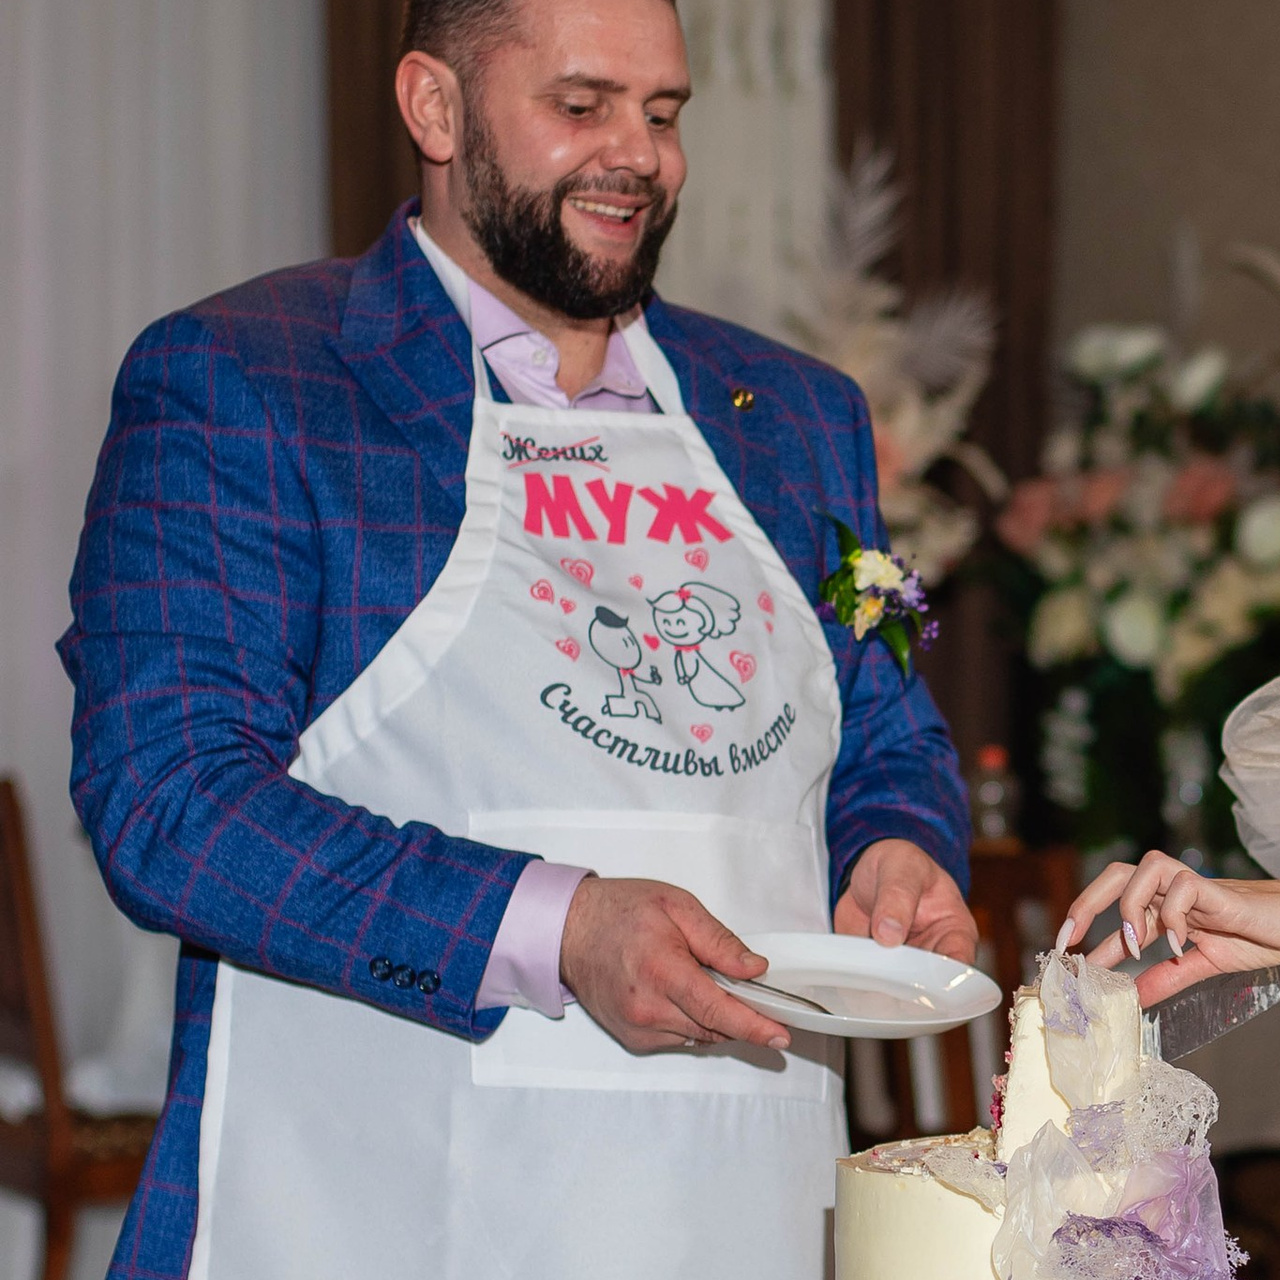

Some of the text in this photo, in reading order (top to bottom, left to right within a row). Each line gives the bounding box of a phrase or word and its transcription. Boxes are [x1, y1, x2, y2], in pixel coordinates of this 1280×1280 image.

[501, 435, 608, 462] Жених
[523, 472, 735, 545] МУЖ
[540, 683, 796, 777] Счастливы вместе
